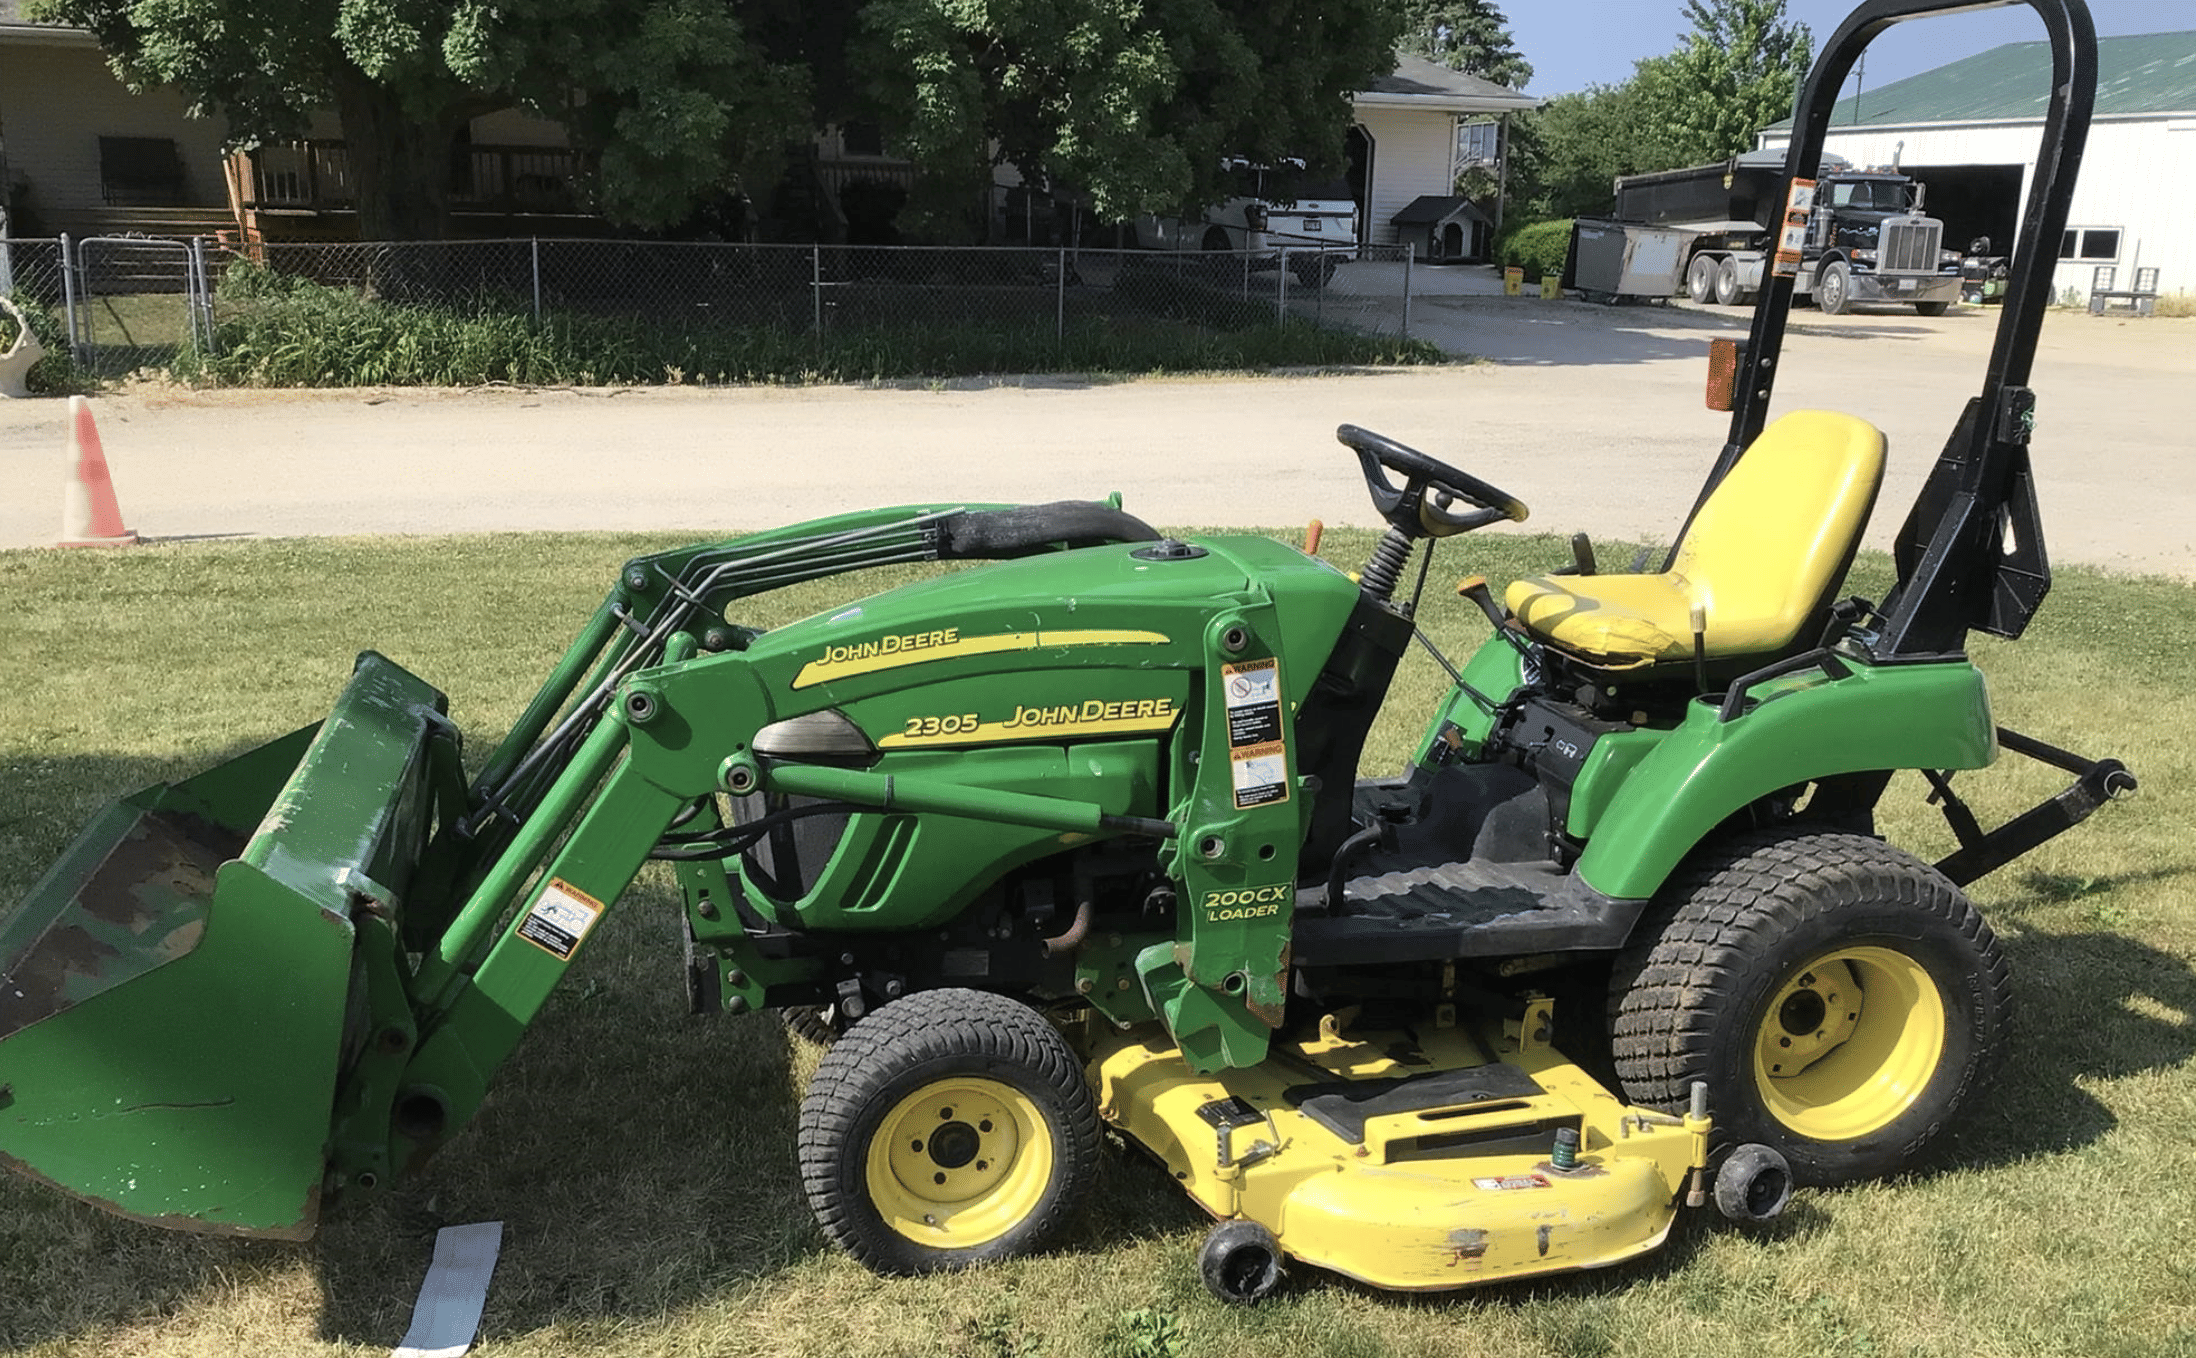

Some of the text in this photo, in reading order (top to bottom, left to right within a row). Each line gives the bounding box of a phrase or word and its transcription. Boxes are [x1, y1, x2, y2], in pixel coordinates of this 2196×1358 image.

[816, 627, 960, 666] JOHN DEERE
[904, 698, 1172, 737] 2305 JOHN DEERE
[1205, 885, 1287, 908] 200CX
[1209, 904, 1279, 922] LOADER
